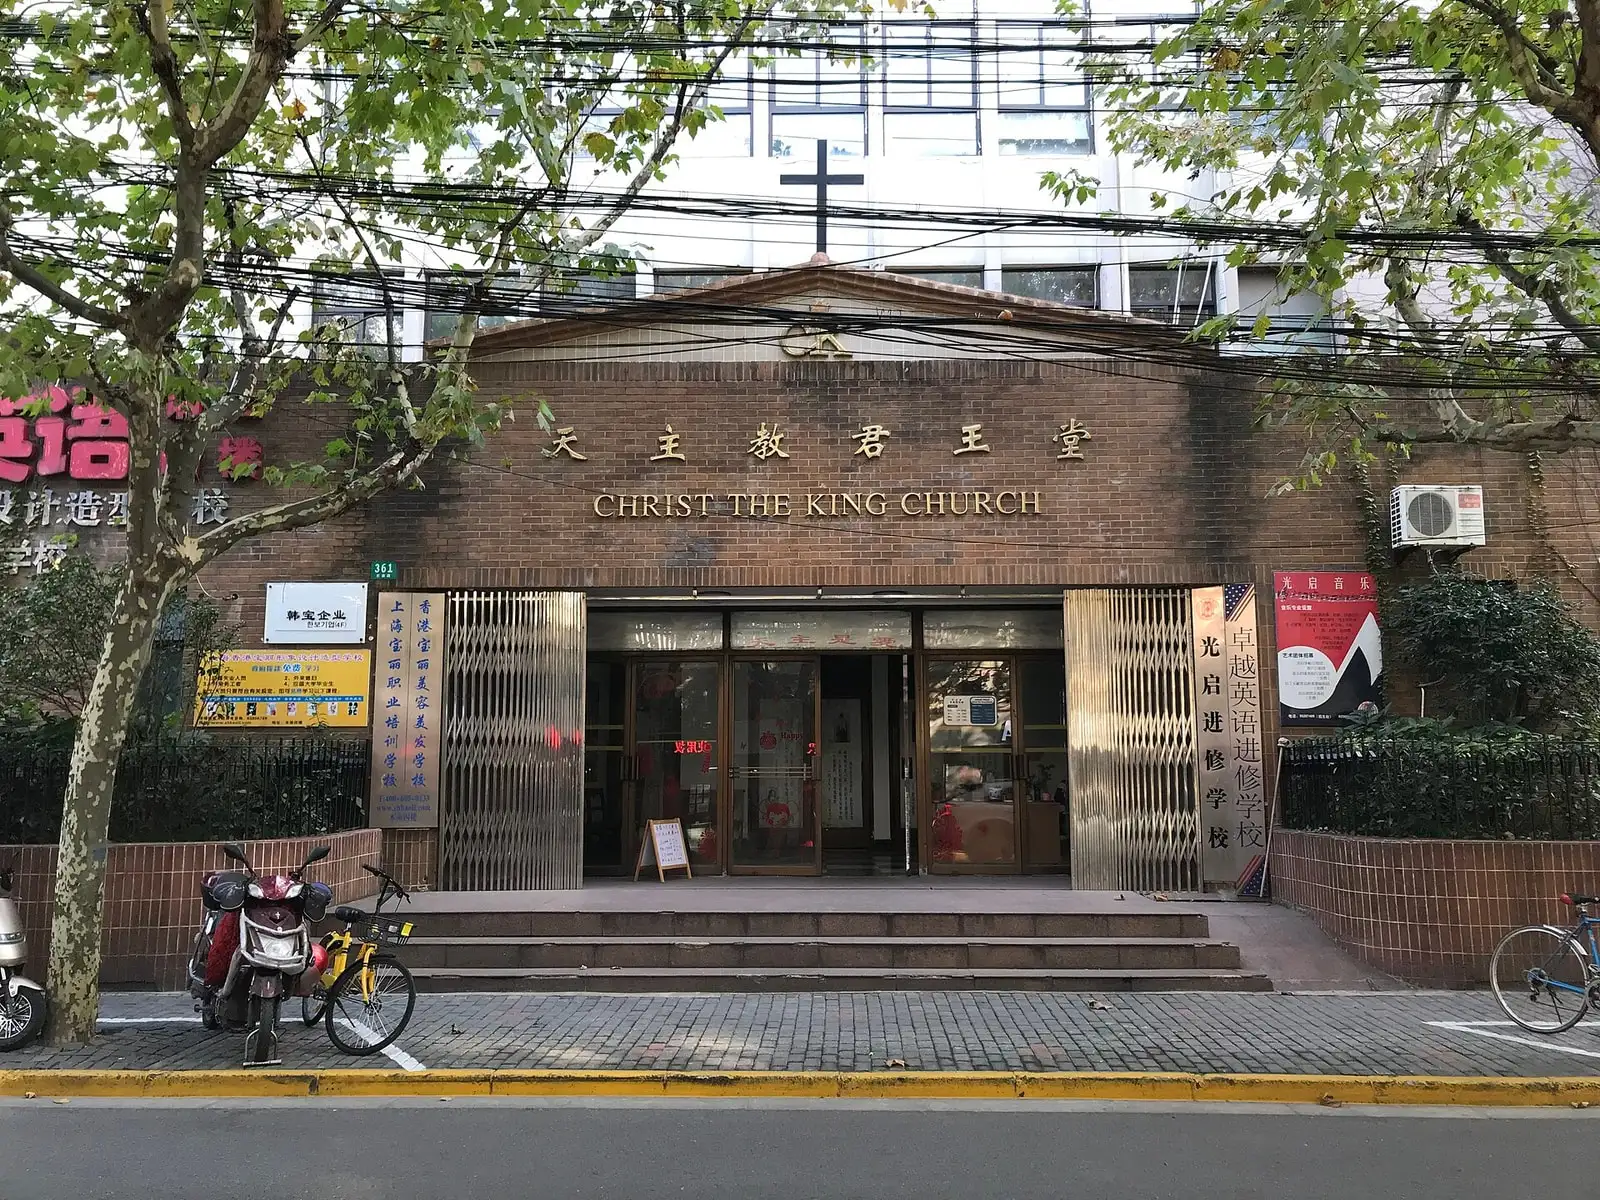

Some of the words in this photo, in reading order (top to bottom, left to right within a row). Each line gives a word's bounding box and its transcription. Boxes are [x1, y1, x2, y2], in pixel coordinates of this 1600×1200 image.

[552, 419, 1092, 460] 天主教君王堂
[593, 493, 714, 518] CHRIST
[727, 493, 792, 517] THE
[805, 492, 888, 517] KING
[901, 491, 1042, 516] CHURCH
[374, 563, 393, 573] 361
[1282, 576, 1371, 590] 光启音乐
[286, 609, 347, 621] 韩宝企业
[382, 600, 405, 788] 上海宝丽职业培训学校
[411, 599, 433, 788] 香港宝丽美容美发学校
[1200, 635, 1229, 849] 光启进修学校
[1229, 626, 1264, 848] 卓越英语进修学校
